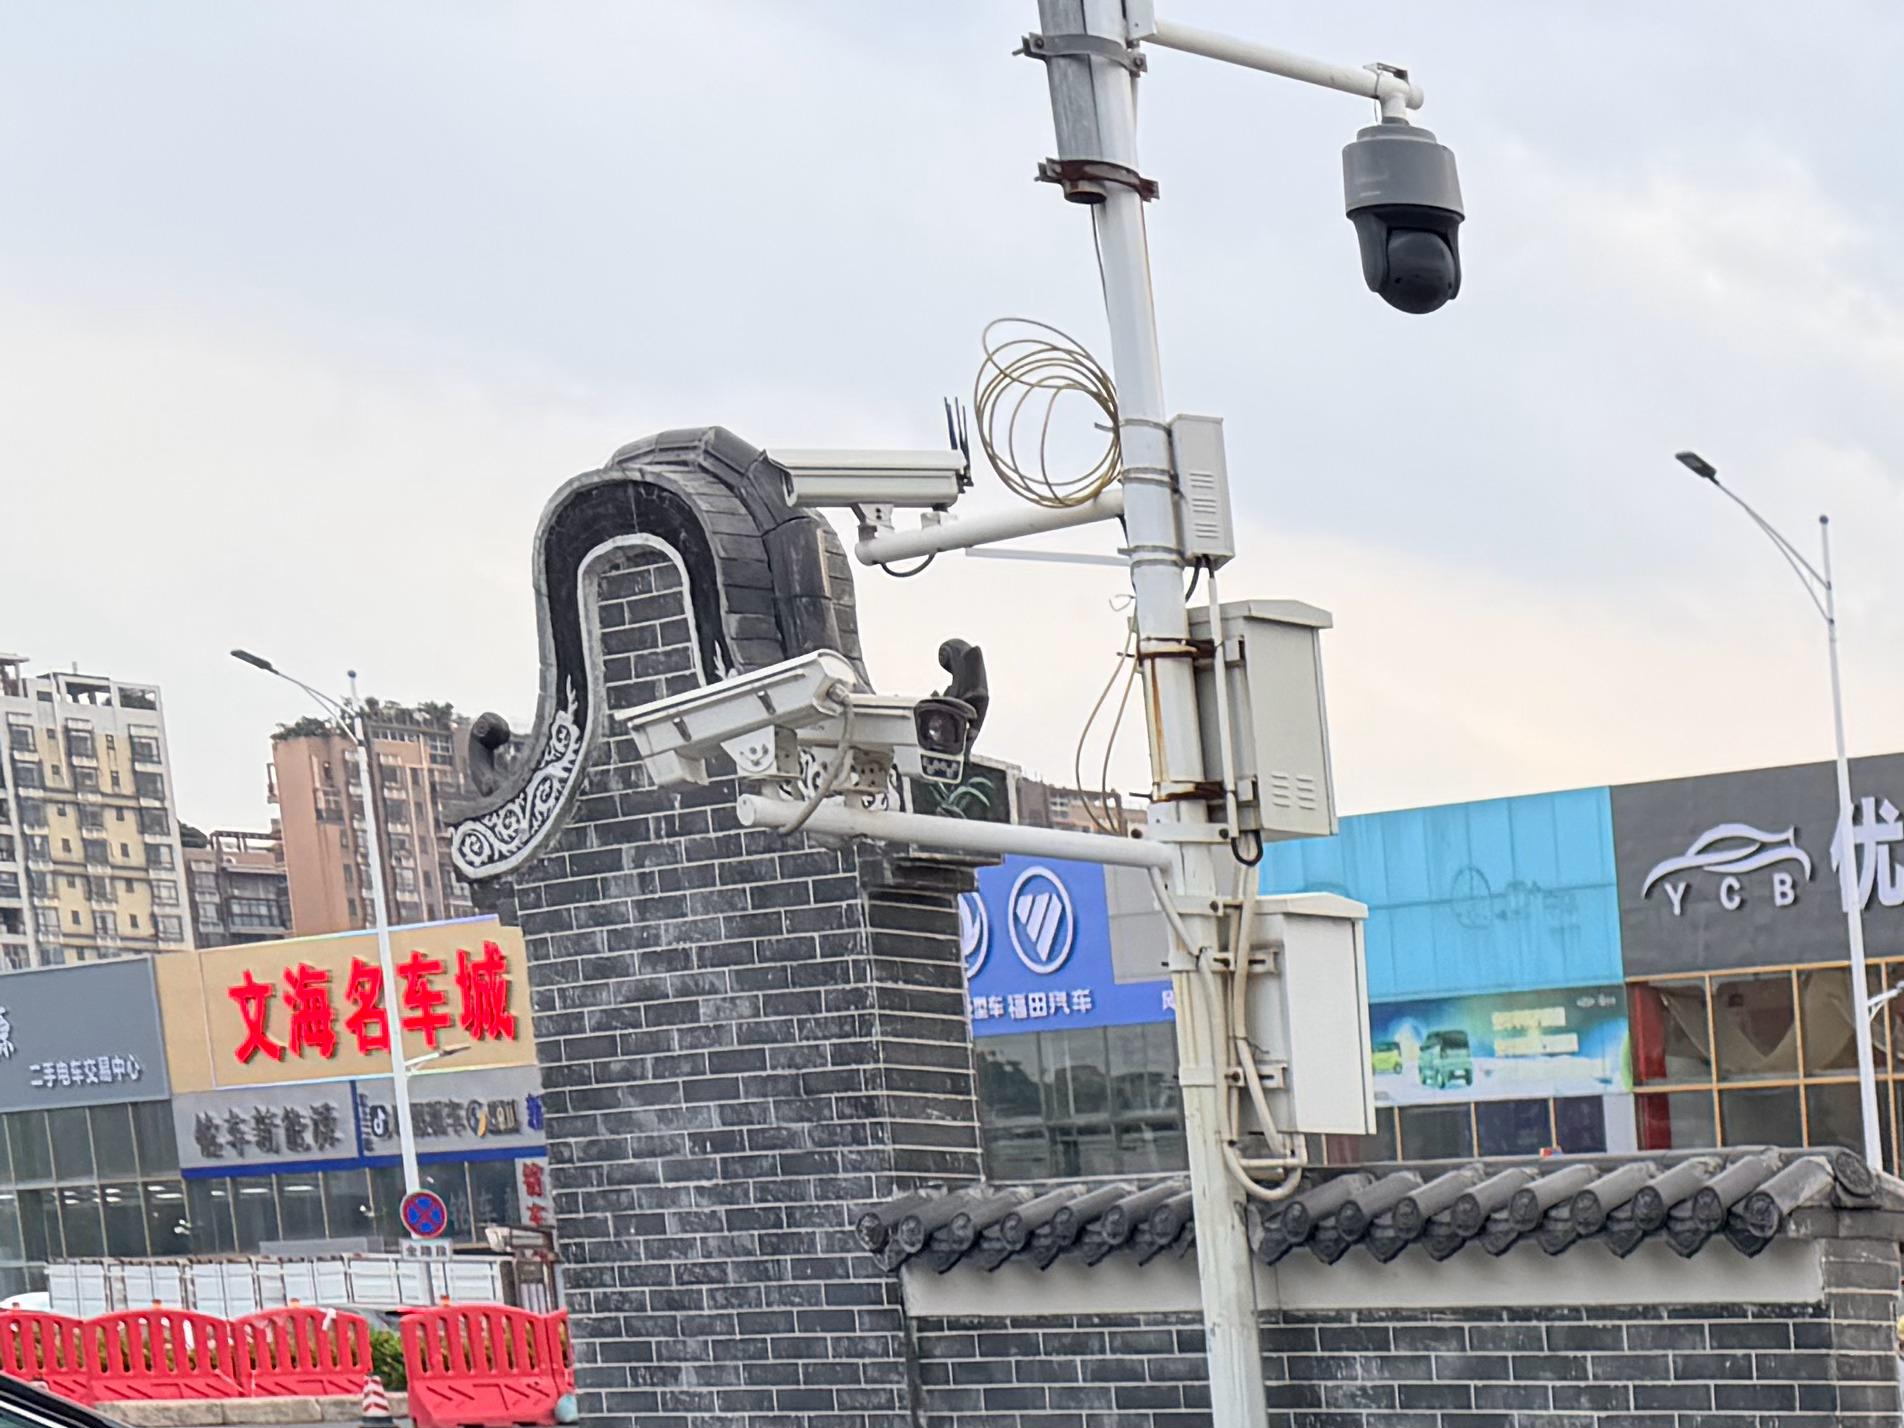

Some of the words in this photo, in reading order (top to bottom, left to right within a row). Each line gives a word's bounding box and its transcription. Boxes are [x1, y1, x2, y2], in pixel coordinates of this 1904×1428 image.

[228, 940, 515, 1064] 文海名车城
[1008, 989, 1092, 1019] 福田汽车
[29, 1054, 141, 1087] 二手电车交易中心
